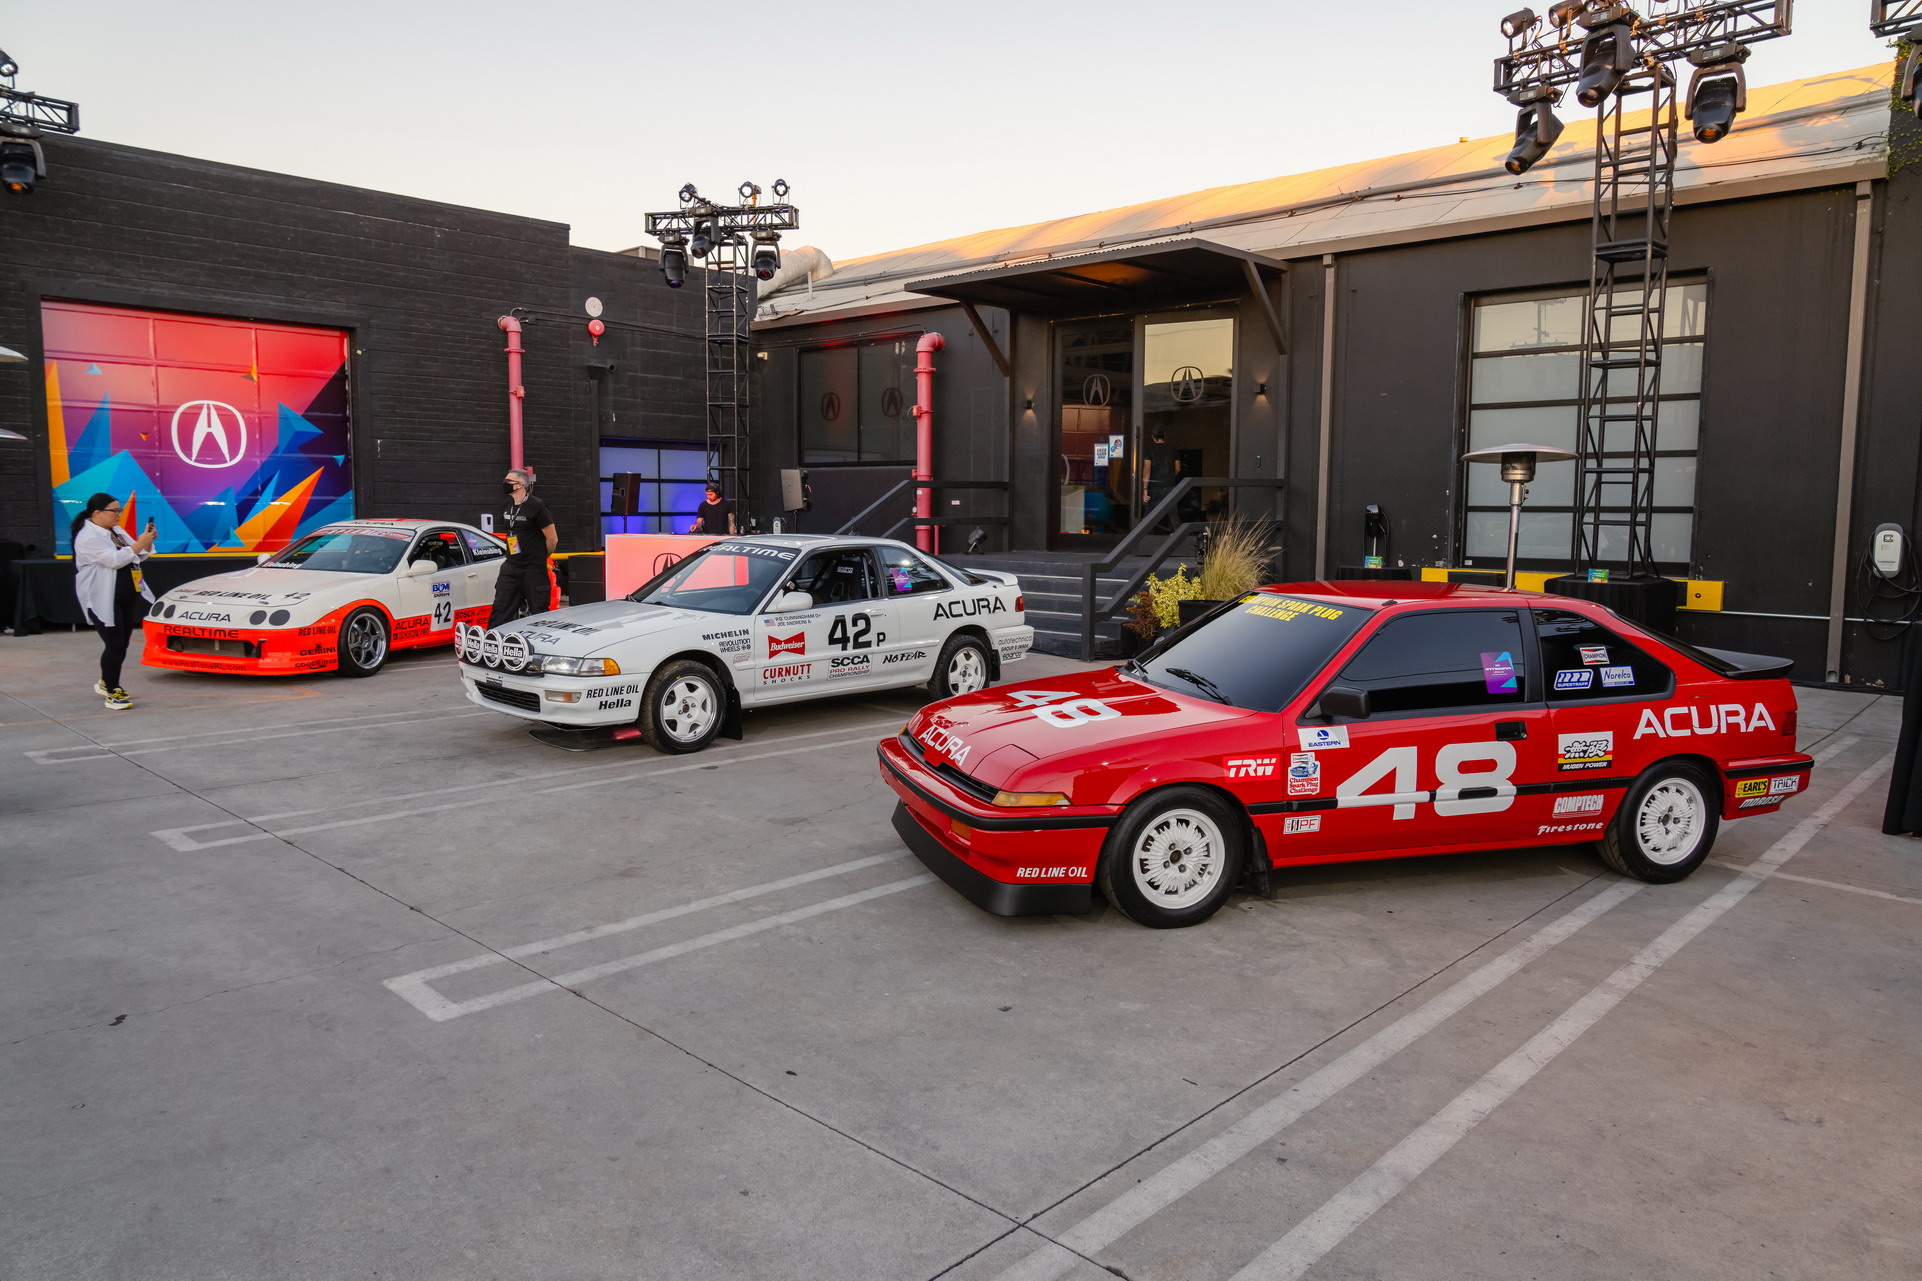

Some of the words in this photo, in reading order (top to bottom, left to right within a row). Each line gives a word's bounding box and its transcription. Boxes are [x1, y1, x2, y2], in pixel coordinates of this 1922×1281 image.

[434, 601, 451, 624] 42
[455, 610, 475, 620] BOSCH
[933, 596, 1007, 621] ACURA
[1245, 605, 1299, 621] CHALLENGE
[1277, 599, 1316, 613] SPARK
[1308, 606, 1344, 620] PLUG
[178, 611, 231, 622] ACURA
[298, 628, 311, 636] RED
[313, 626, 326, 635] LINE
[328, 625, 336, 634] OIL
[395, 617, 430, 631] ACURA
[164, 625, 239, 638] REALTIME
[702, 629, 750, 640] MICHELIN
[828, 613, 872, 651] 42
[467, 638, 480, 650] Hella
[877, 632, 886, 647] P
[300, 647, 336, 656] GEMINI
[484, 643, 498, 654] Hella
[503, 646, 523, 657] Hella
[719, 645, 740, 653] WHEELS
[770, 641, 804, 652] Budweiser
[295, 659, 337, 667] GOODRIDGE
[831, 654, 870, 668] SCCA
[763, 663, 812, 680] CURNUTT
[829, 669, 870, 679] CHAMPIONSHIP
[1604, 669, 1631, 681] Norelco
[586, 689, 604, 698] RED
[605, 686, 625, 697] LINE
[626, 684, 640, 694] OIL
[599, 699, 631, 710] Hella
[1006, 690, 1122, 728] 48
[1633, 702, 1776, 740] ACURA
[918, 726, 972, 766] ACURA
[1564, 739, 1609, 759] 無限
[1227, 758, 1277, 778] TRW
[1585, 761, 1608, 769] POWER
[1336, 741, 1517, 820] 48
[1743, 780, 1768, 793] EARL'S
[1554, 794, 1604, 813] COMPTECH
[1537, 822, 1604, 835] Firestone
[1016, 867, 1040, 878] RED
[1041, 867, 1067, 878] LINE
[1068, 866, 1088, 878] OIL
